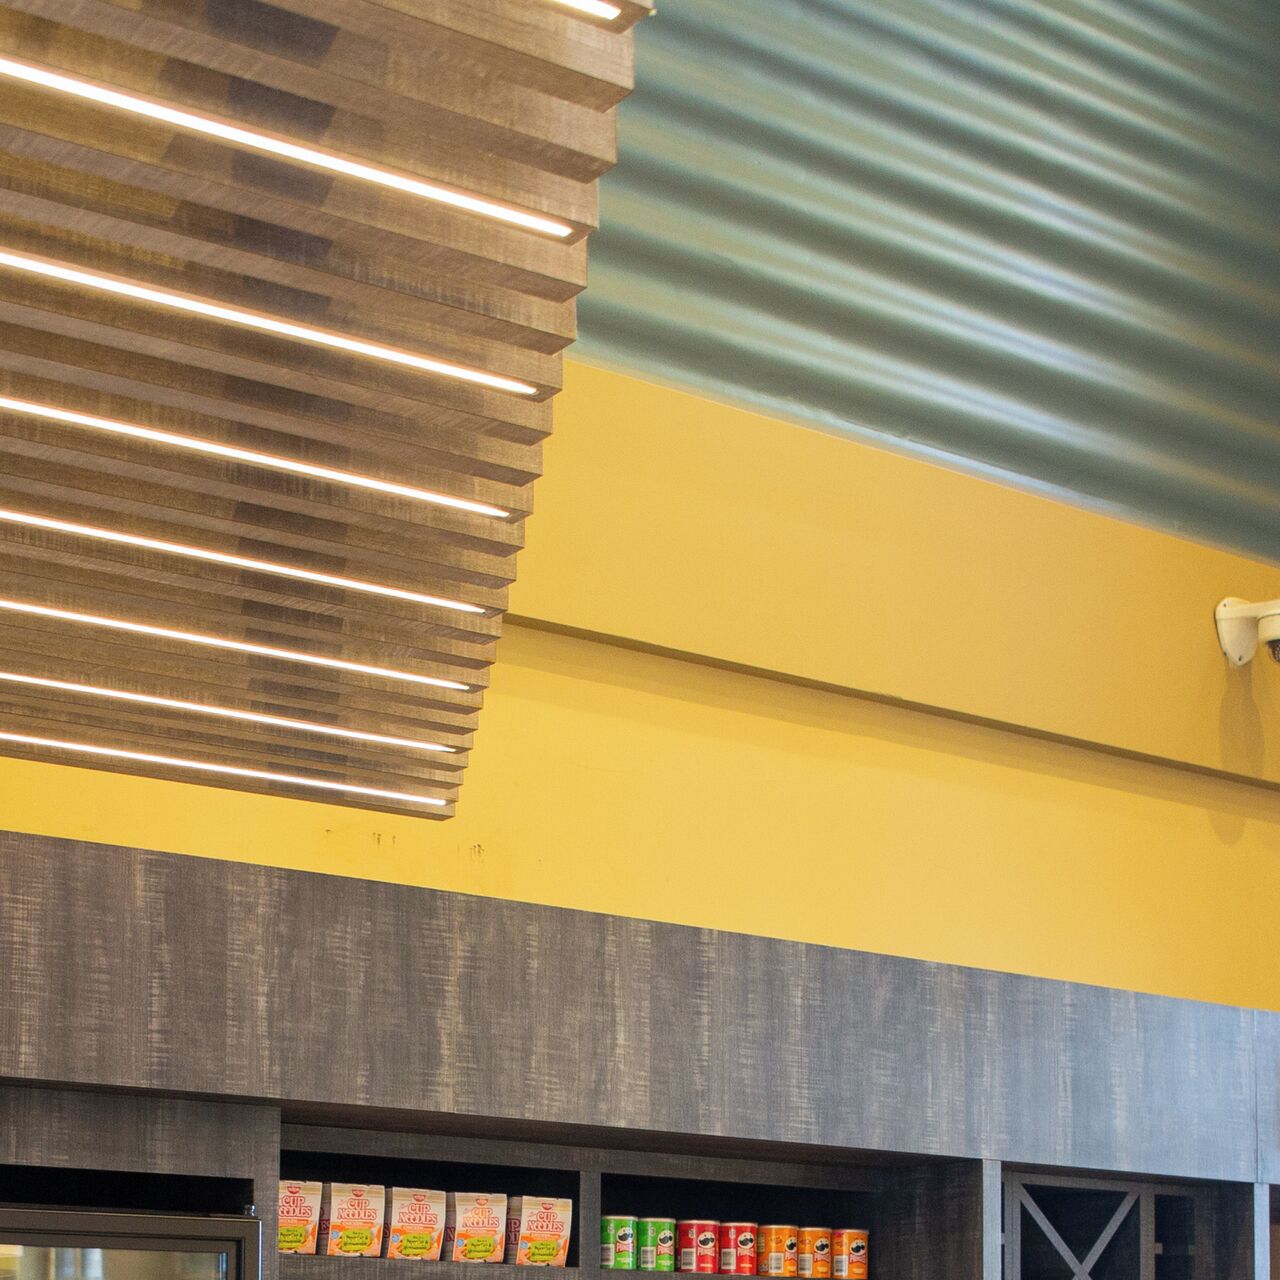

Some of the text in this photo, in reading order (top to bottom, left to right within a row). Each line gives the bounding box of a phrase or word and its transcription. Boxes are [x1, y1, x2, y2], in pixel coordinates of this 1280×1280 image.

[347, 1199, 369, 1209] CUP
[408, 1203, 431, 1214] CUP
[337, 1208, 377, 1220] NOODLES
[472, 1207, 492, 1218] CUP
[536, 1212, 556, 1223] CUP
[398, 1213, 438, 1225] NOODLES
